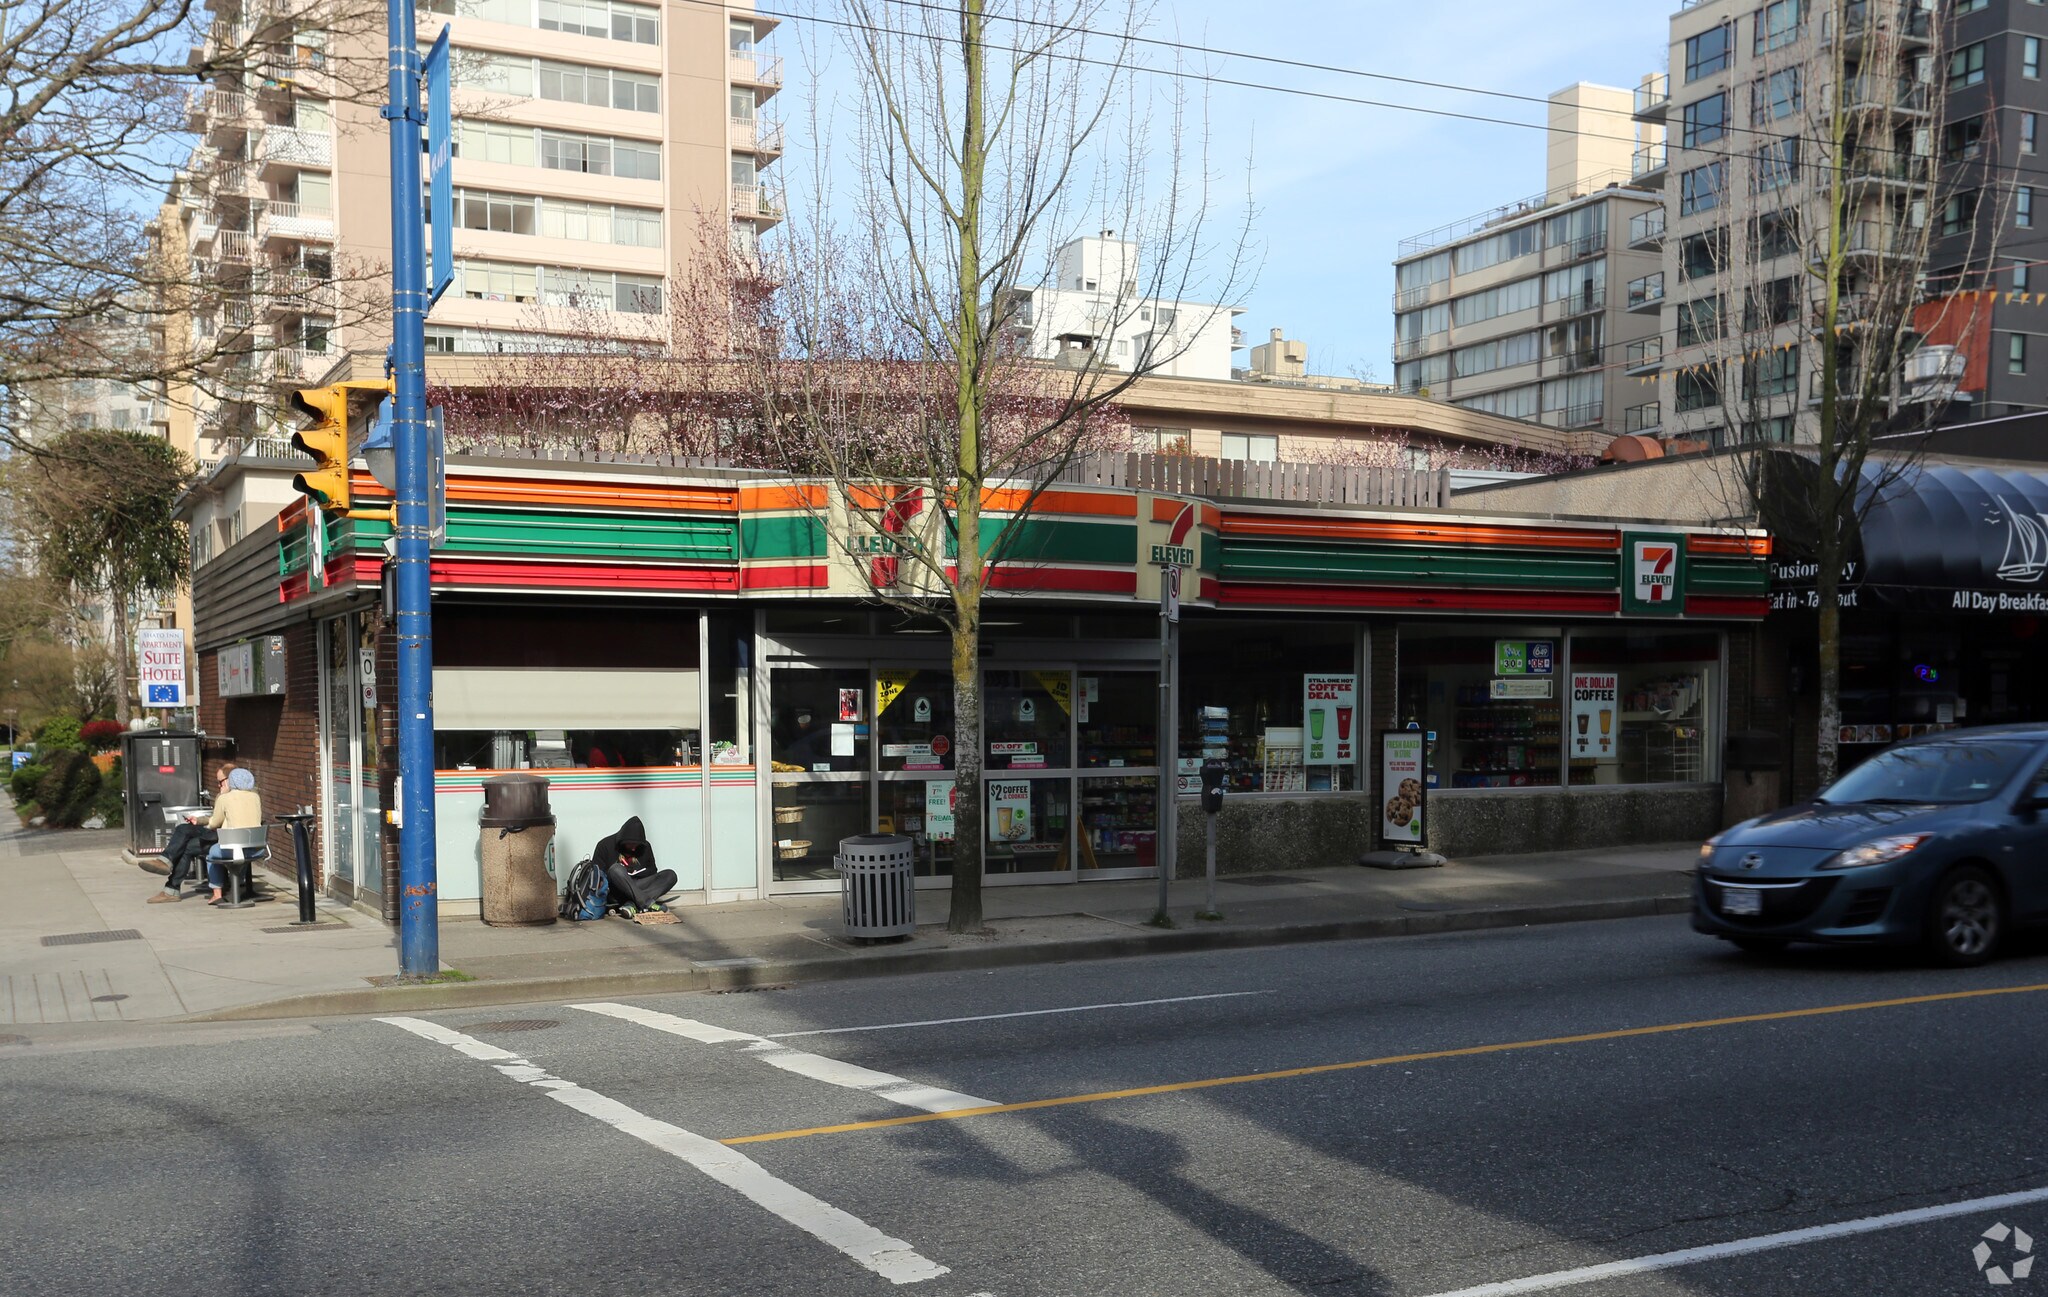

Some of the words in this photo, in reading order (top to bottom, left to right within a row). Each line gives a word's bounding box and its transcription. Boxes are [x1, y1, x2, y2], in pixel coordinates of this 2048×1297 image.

[1642, 547, 1673, 600] 7
[1770, 560, 1819, 579] Fusion
[1786, 592, 1797, 608] in
[1952, 591, 1970, 608] All
[1972, 591, 1998, 613] Day
[141, 640, 183, 649] APARTMENT
[144, 650, 181, 664] SUITE
[142, 668, 184, 681] HOTEL
[881, 680, 893, 690] ID
[1056, 682, 1067, 691] ID
[1308, 683, 1352, 691] COFFEE
[1575, 677, 1588, 688] ONE
[1590, 677, 1615, 688] DOLLAR
[880, 688, 898, 697] ZONE
[1052, 688, 1069, 699] ZONE
[1574, 689, 1614, 700] COFFEE
[1386, 741, 1403, 749] FRESH
[990, 784, 1002, 801] $2
[1003, 785, 1028, 793] COFFEE
